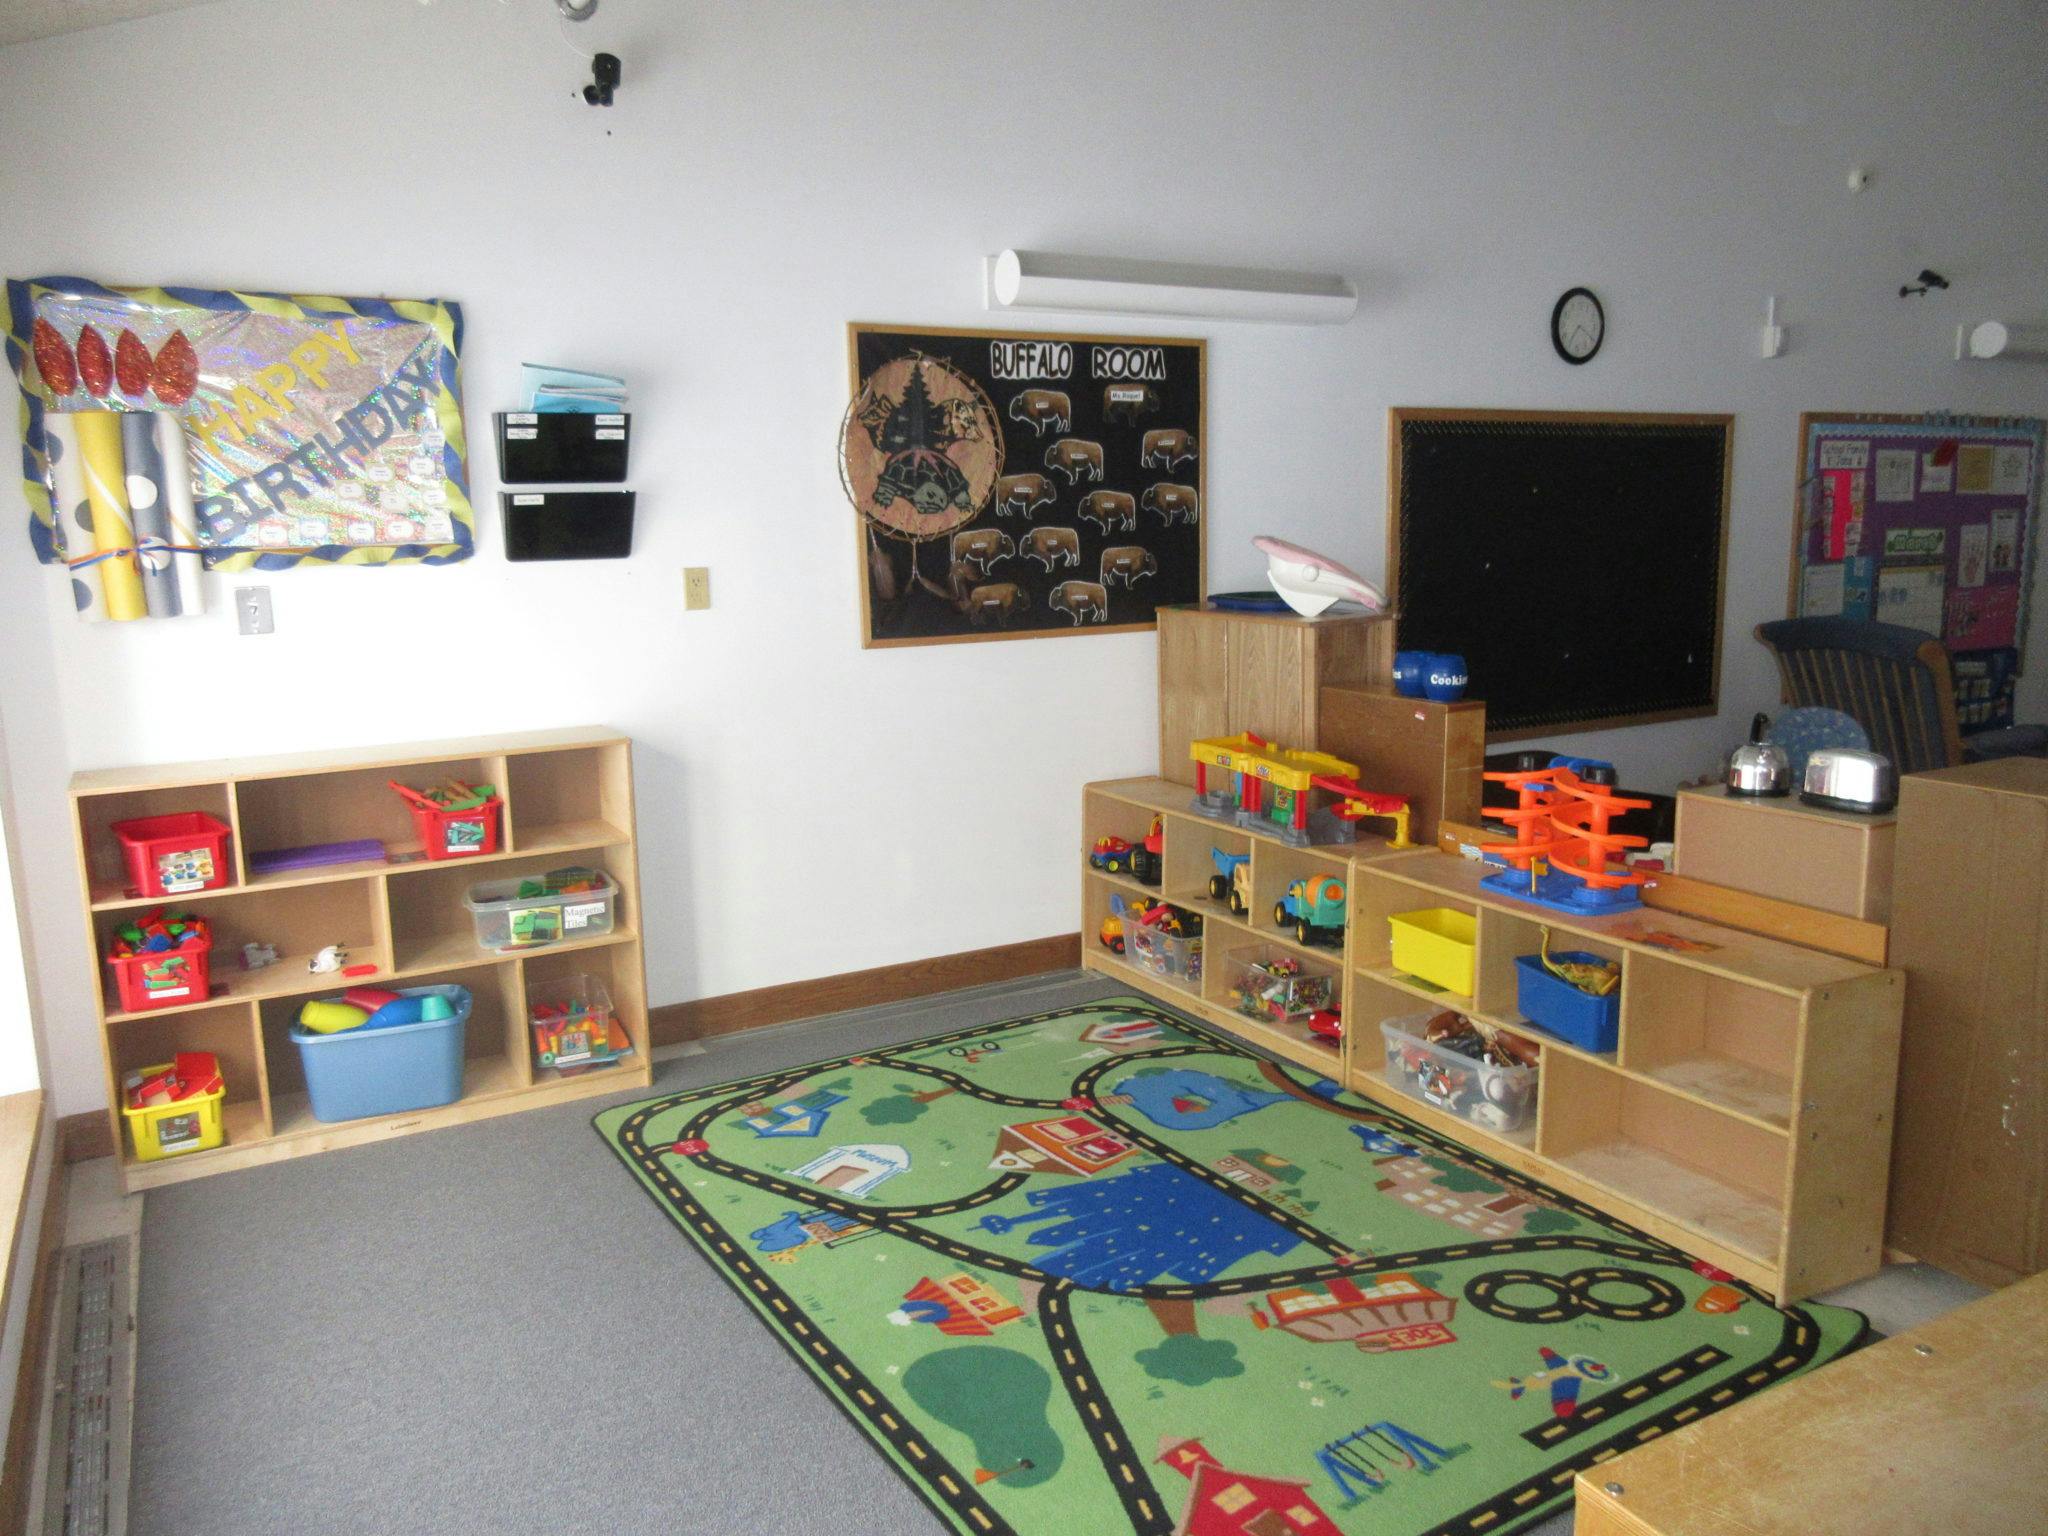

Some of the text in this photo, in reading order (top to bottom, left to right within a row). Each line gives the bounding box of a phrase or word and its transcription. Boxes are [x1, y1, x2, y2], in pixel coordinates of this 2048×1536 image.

[991, 341, 1166, 380] BUFFALO ROOM
[187, 320, 362, 457] HAPPY
[193, 356, 441, 540] BIRTHDAY
[1430, 673, 1468, 686] Cooki
[565, 904, 605, 917] Magnetic
[565, 918, 587, 928] Tiles
